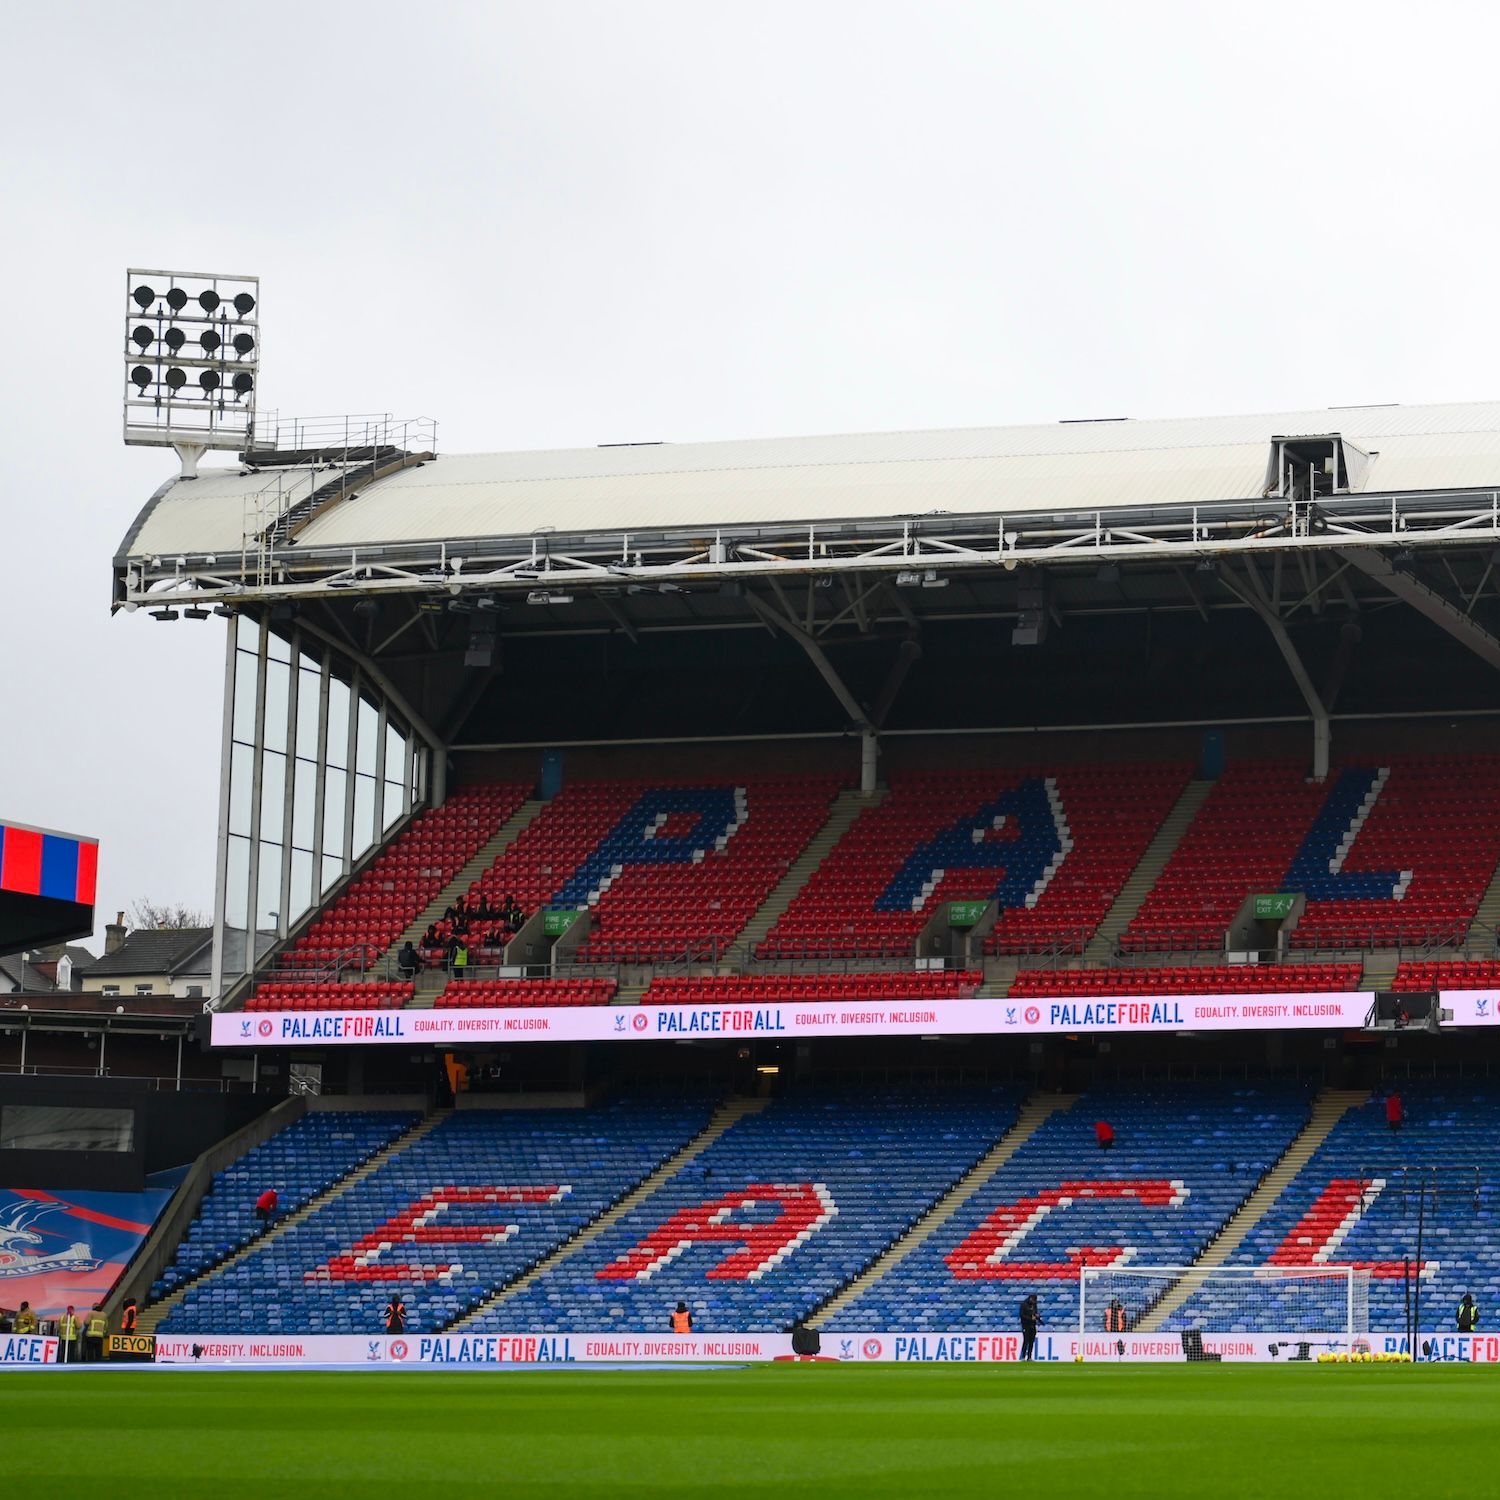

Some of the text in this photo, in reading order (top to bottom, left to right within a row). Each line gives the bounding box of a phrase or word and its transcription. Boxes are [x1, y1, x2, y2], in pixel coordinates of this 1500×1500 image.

[658, 1010, 938, 1032] PALACEFORALL EQUALITY. DIVERSITY. INCLUSION.
[1050, 1003, 1344, 1025] PALACEFORALL EQUALITY. DIVERSITY. INCLUSION.
[282, 1017, 551, 1038] PALACEFORALL EQUALITY. DIVERSITY. INCLUSION.
[0, 1338, 58, 1365] ACEF
[250, 1344, 306, 1357] INCLUSION.
[420, 1338, 762, 1362] PALACEFORALL EQUALITY. DIVERSITY. INCLUSION.
[895, 1337, 1060, 1361] PALACEFORLL
